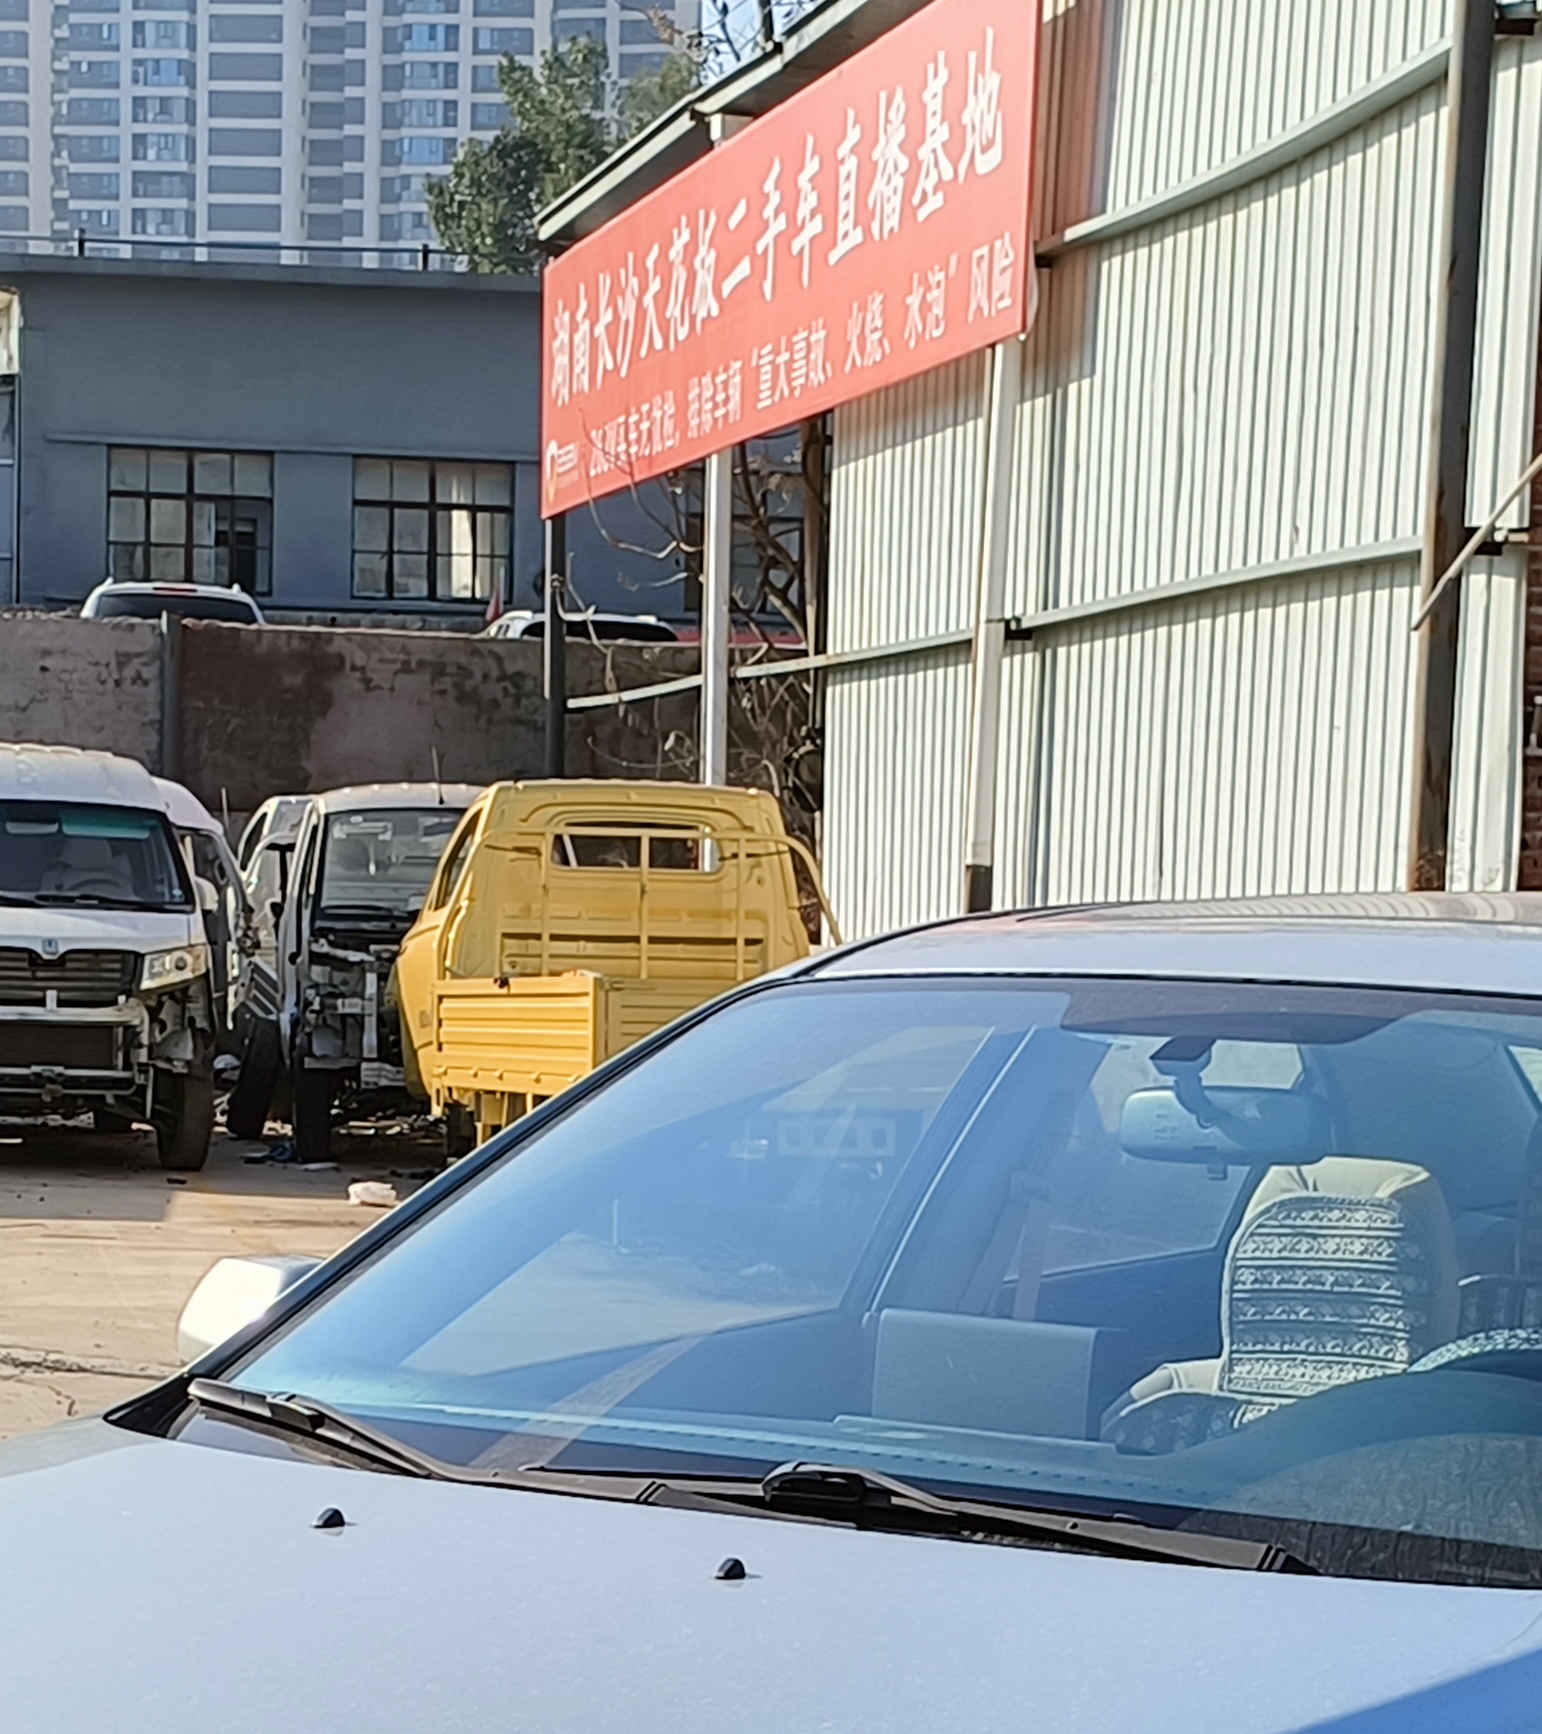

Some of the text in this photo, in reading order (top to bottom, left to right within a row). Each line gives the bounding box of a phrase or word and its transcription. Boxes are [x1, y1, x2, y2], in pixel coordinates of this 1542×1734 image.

[552, 27, 1002, 407] 湖南长沙天花板二手车直播基地
